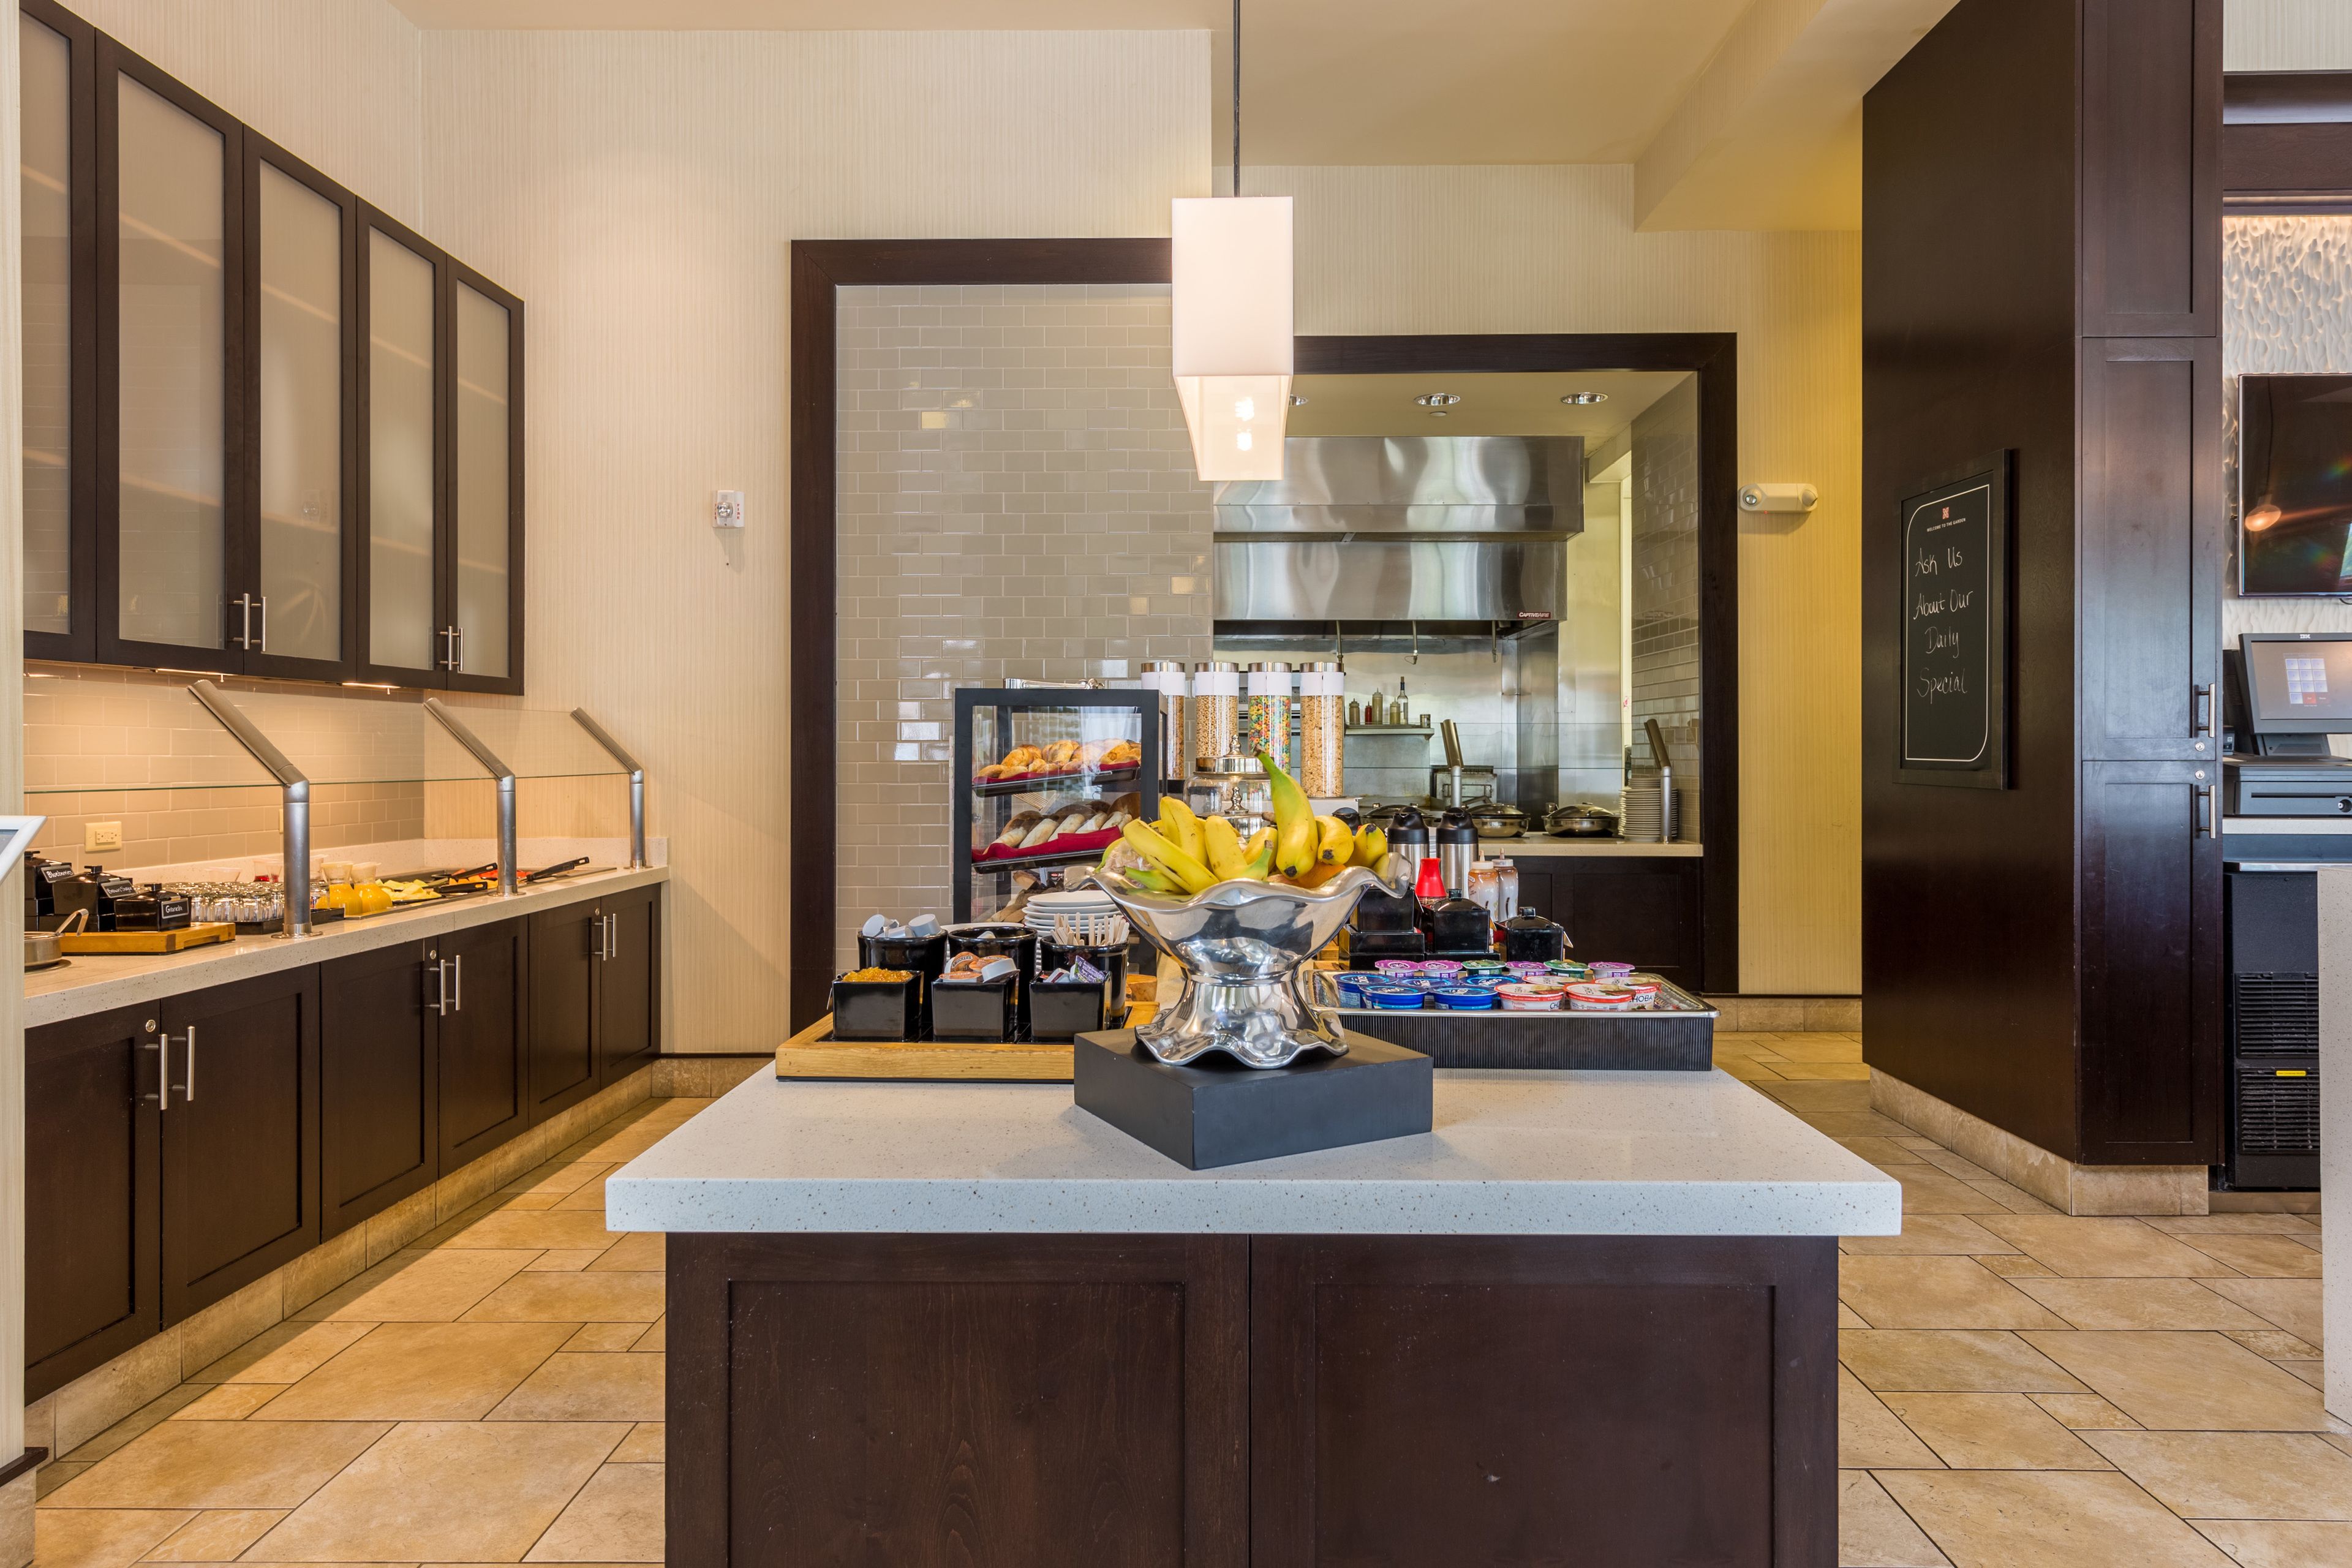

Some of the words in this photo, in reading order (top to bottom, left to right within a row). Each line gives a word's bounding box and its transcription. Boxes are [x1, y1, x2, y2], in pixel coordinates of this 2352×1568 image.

[1915, 547, 1937, 577] Ask
[1948, 546, 1962, 568] Us
[1913, 593, 1945, 620] About
[1950, 589, 1973, 612] Our
[1924, 626, 1959, 658] Daily
[1917, 667, 1968, 704] Special
[47, 870, 74, 878] Blueberries
[165, 905, 183, 913] Granola
